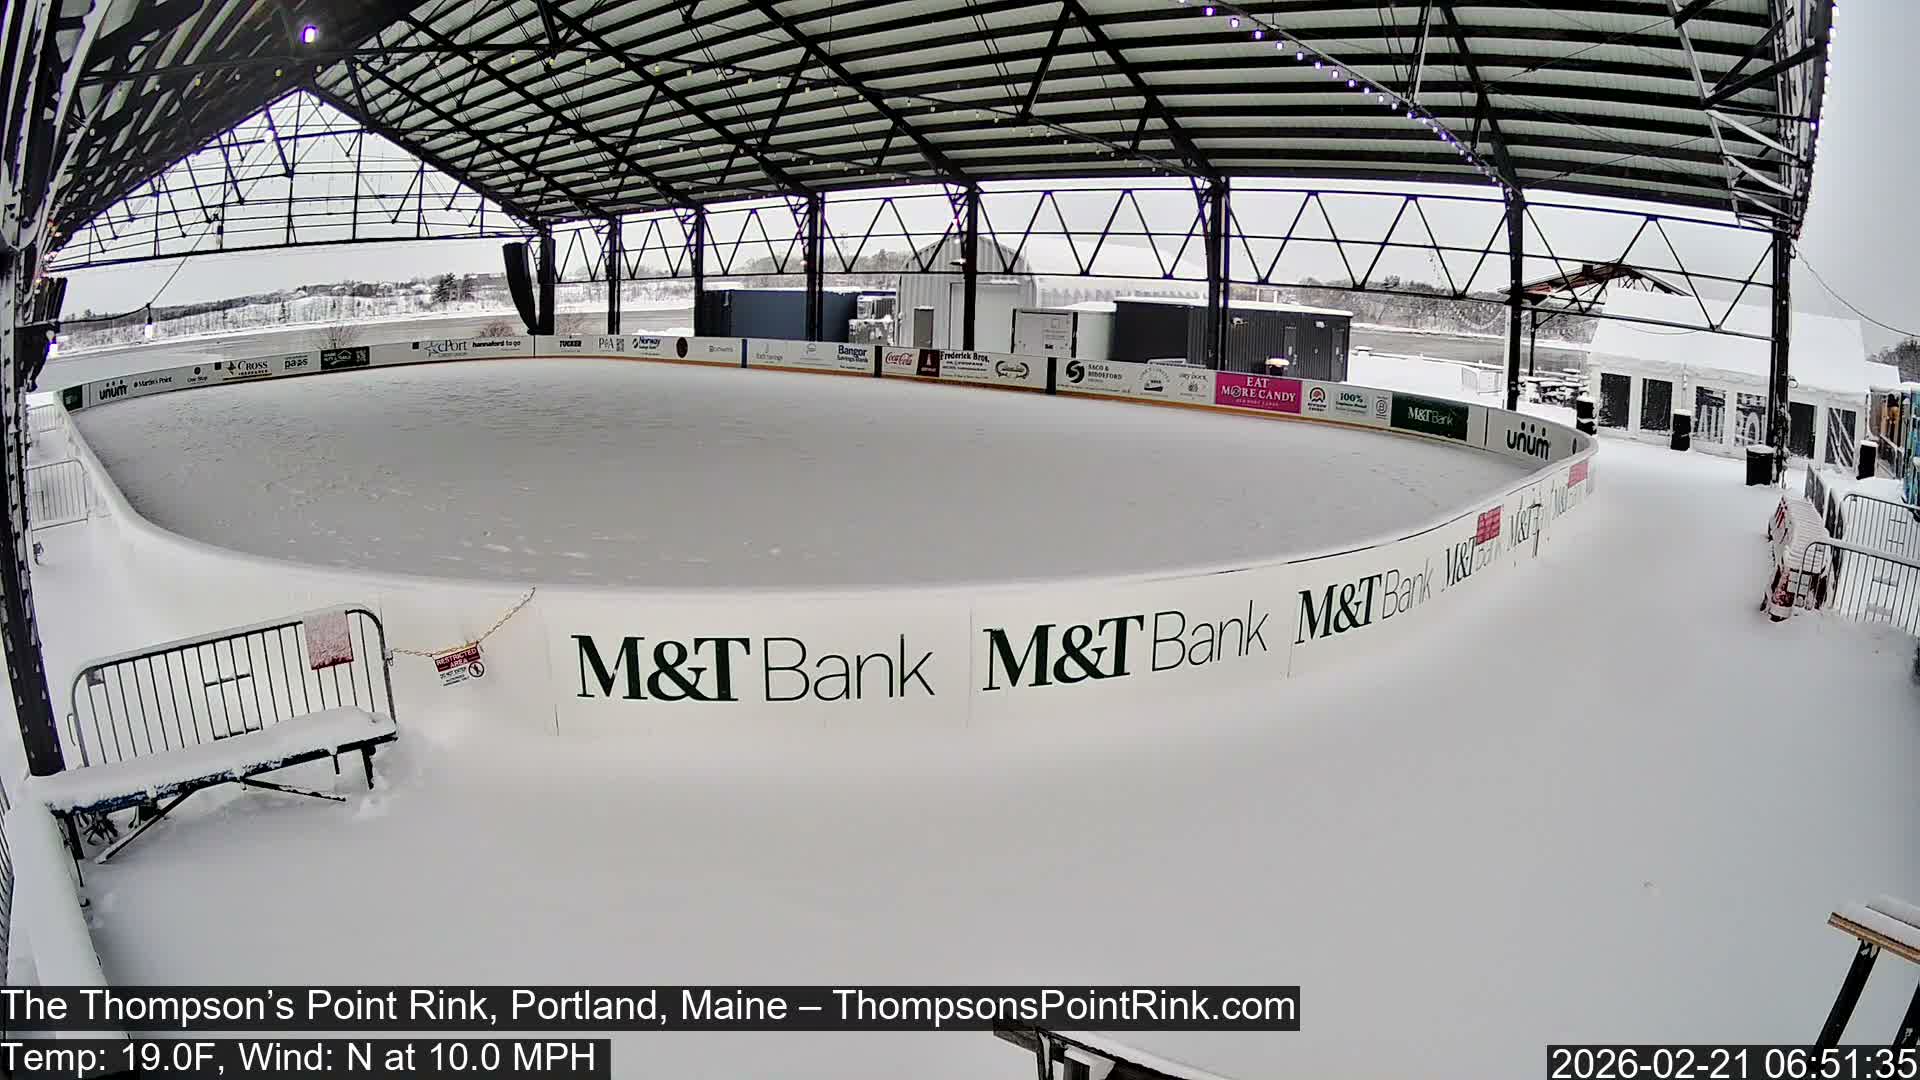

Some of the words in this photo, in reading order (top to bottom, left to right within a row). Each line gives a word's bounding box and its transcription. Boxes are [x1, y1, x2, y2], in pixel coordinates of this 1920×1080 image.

[838, 345, 868, 359] Bangor
[941, 351, 971, 362] Frederick
[973, 352, 990, 364] Bros.
[237, 360, 268, 371] CROSS
[1246, 376, 1269, 388] EAT
[99, 384, 128, 400] unum
[1221, 385, 1257, 398] MORE
[1258, 389, 1297, 402] CANDY
[1340, 393, 1364, 403] 100%
[1408, 406, 1432, 422] M&T
[1431, 410, 1454, 426] Bank
[1506, 427, 1550, 460] unum
[1294, 573, 1383, 645] M&T
[1382, 559, 1434, 620] Bank
[983, 614, 1145, 691] M&T
[1151, 600, 1269, 671] Bank
[436, 648, 478, 666] RESTRICTED
[450, 658, 468, 669] AREA
[571, 635, 750, 701] M&T
[764, 634, 935, 701] Bank
